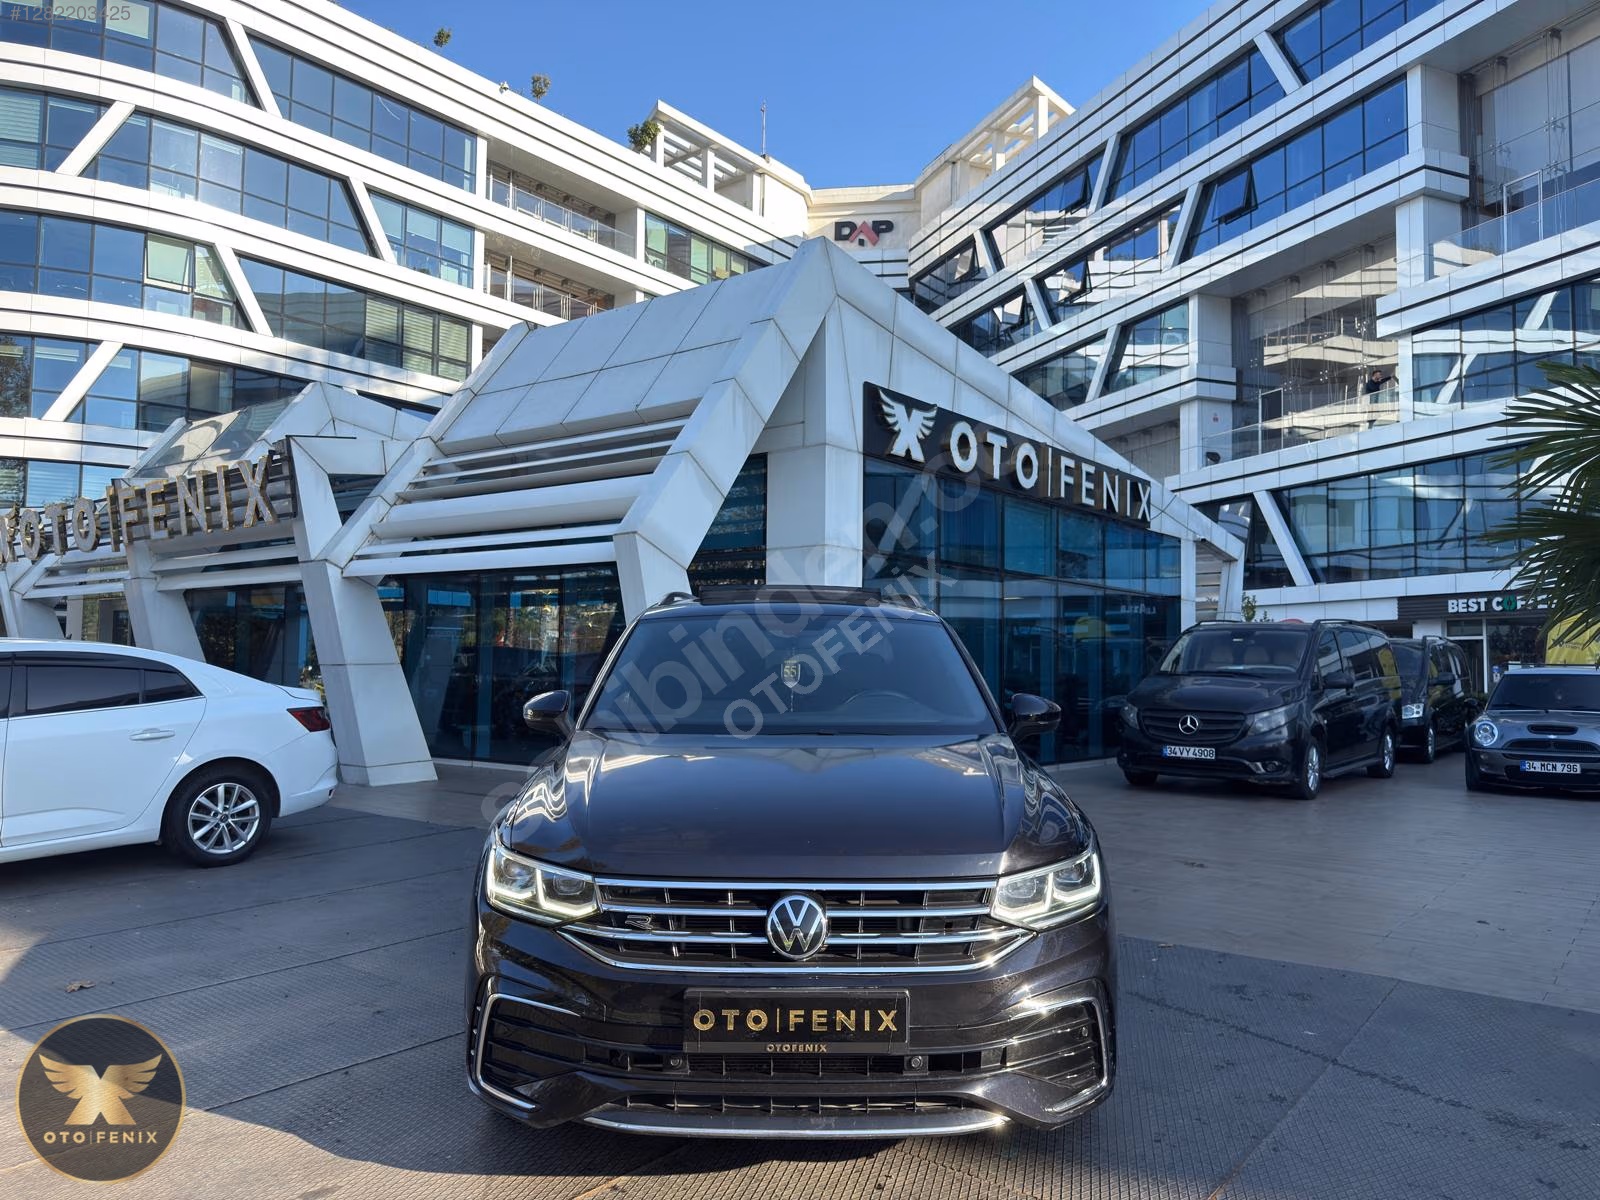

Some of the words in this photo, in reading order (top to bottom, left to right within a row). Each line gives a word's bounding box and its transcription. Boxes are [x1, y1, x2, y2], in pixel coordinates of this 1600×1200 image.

[834, 219, 894, 247] DAP
[1447, 597, 1487, 613] BEST
[1491, 592, 1558, 613] COFE
[1561, 763, 1578, 773] 796
[766, 1043, 828, 1053] OTOFENIX
